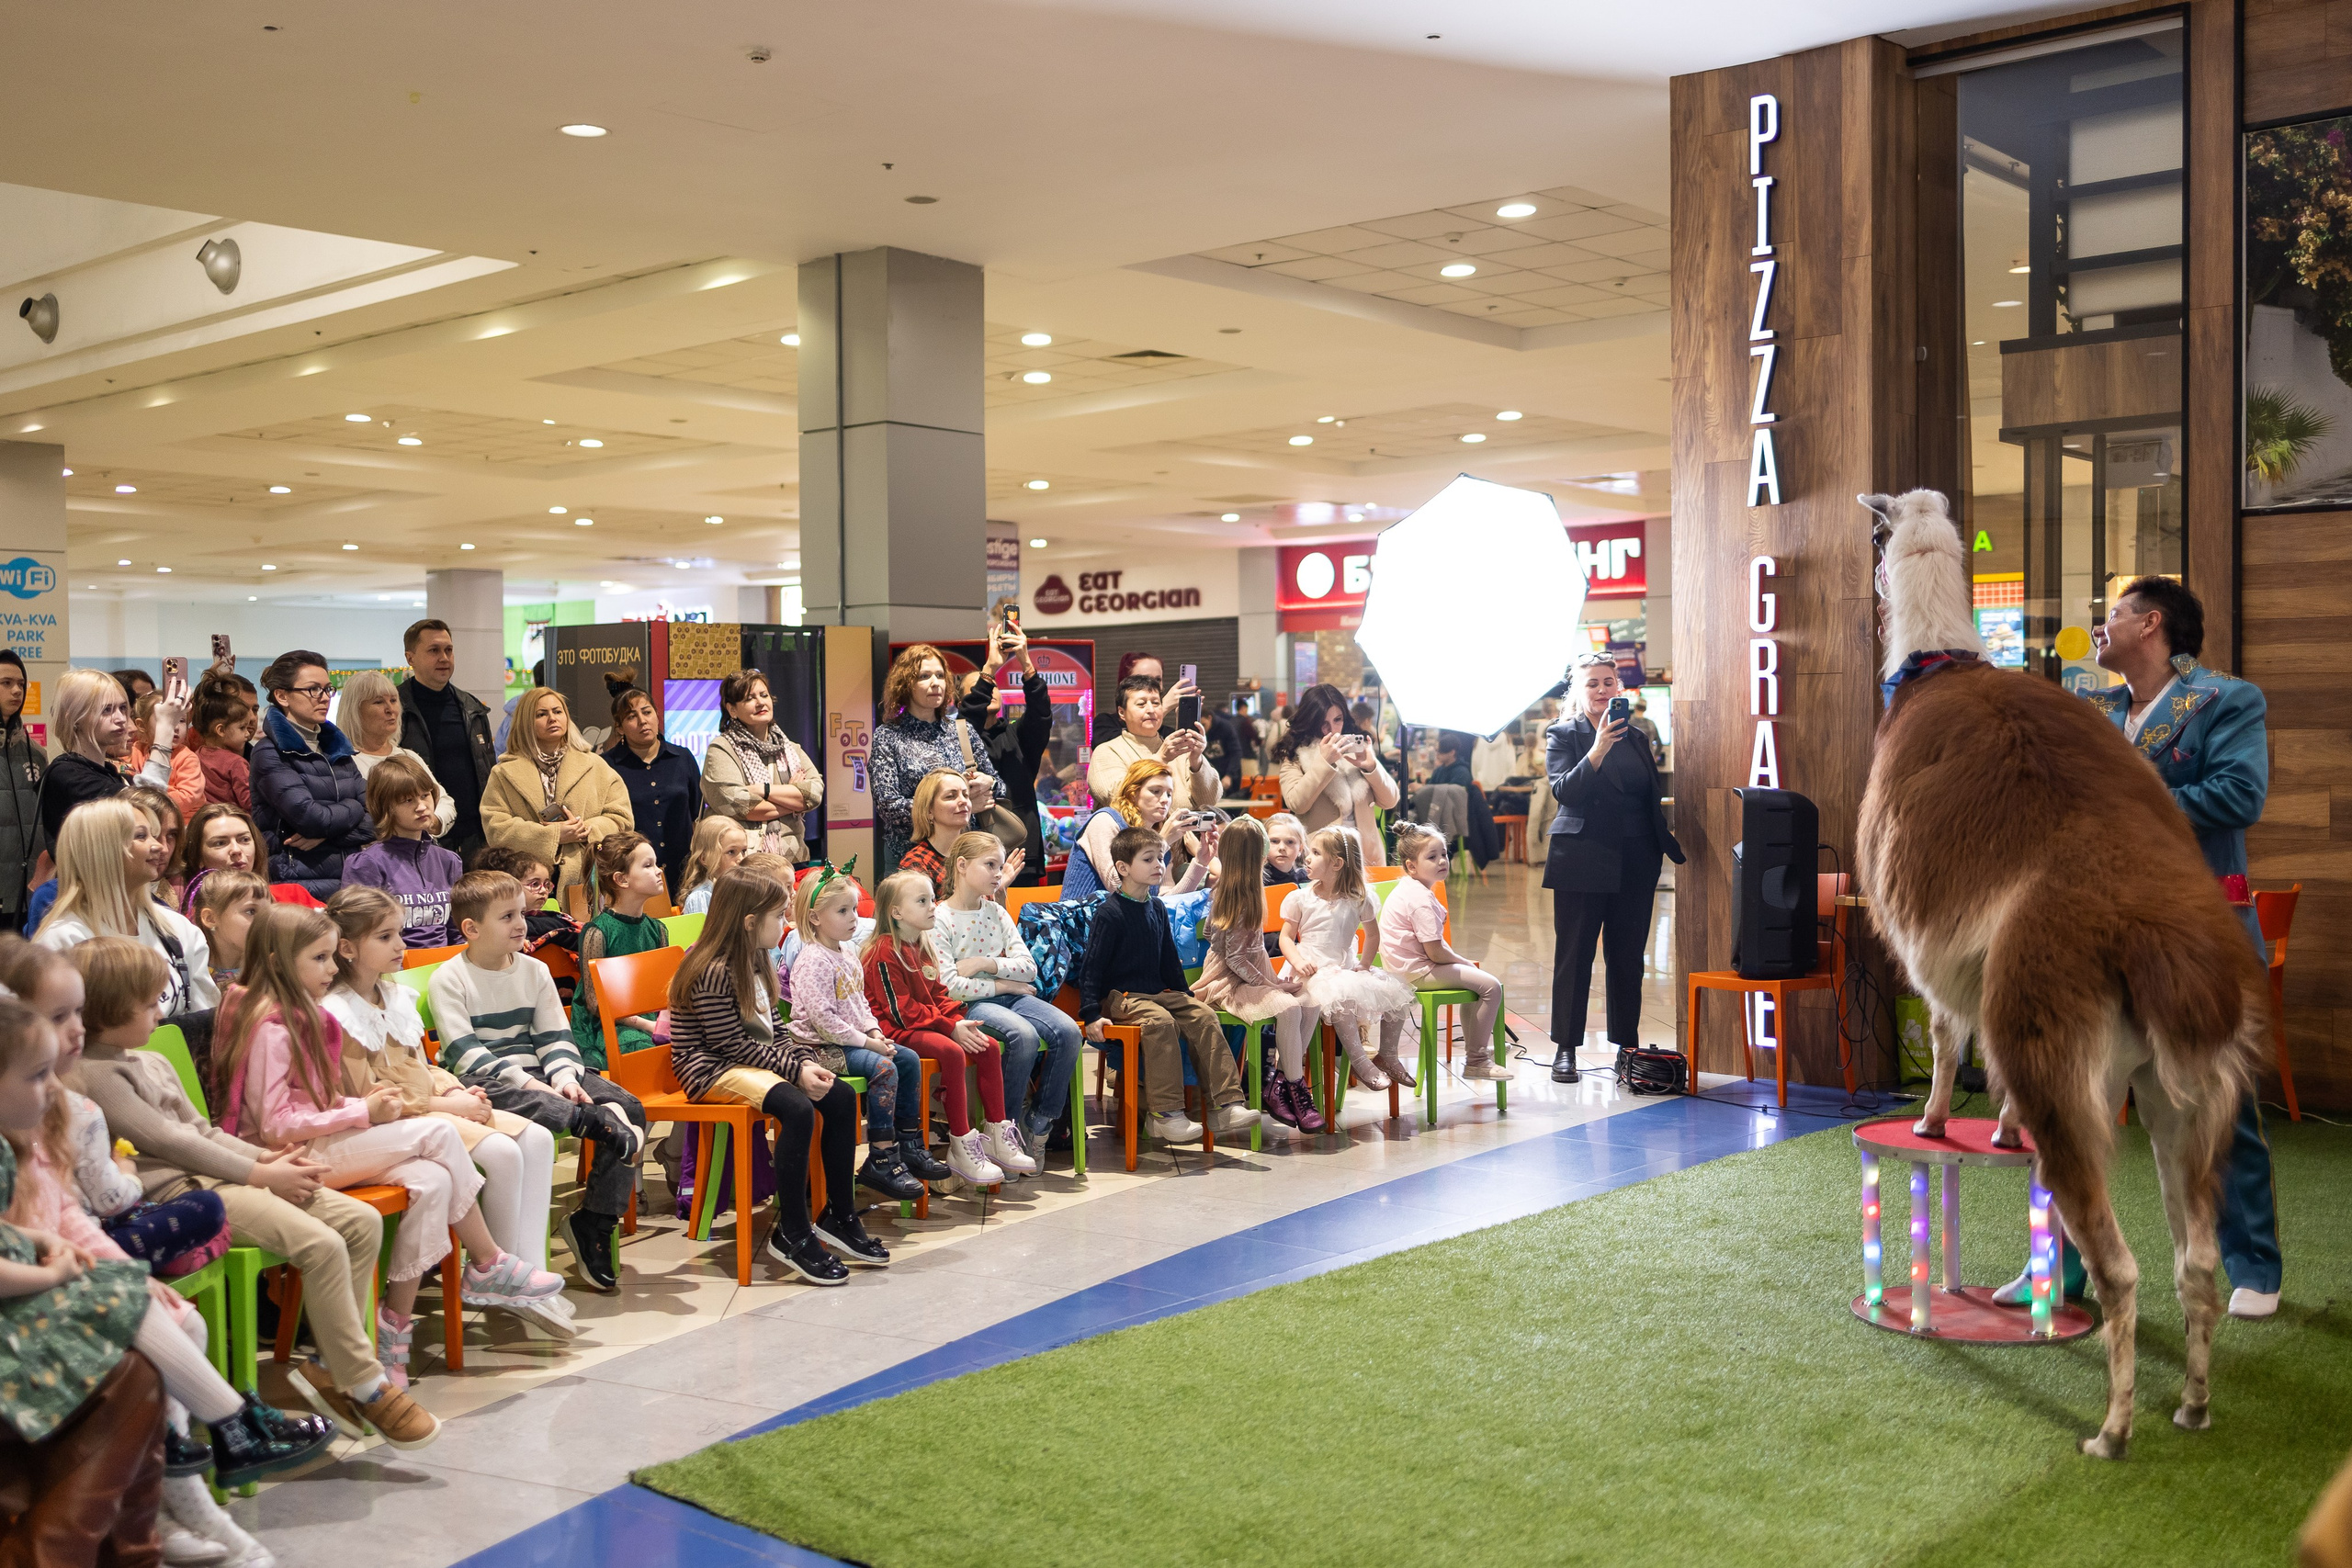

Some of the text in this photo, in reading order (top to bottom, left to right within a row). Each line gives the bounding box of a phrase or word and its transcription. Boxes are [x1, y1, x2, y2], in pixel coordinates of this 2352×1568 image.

[1747, 95, 1781, 507] PIZZA
[987, 540, 1017, 559] stige
[7, 630, 45, 642] PARK
[558, 646, 641, 665] ЭТО ФОТОБУДКА
[1008, 671, 1076, 685] TEHONE
[416, 893, 435, 904] NO
